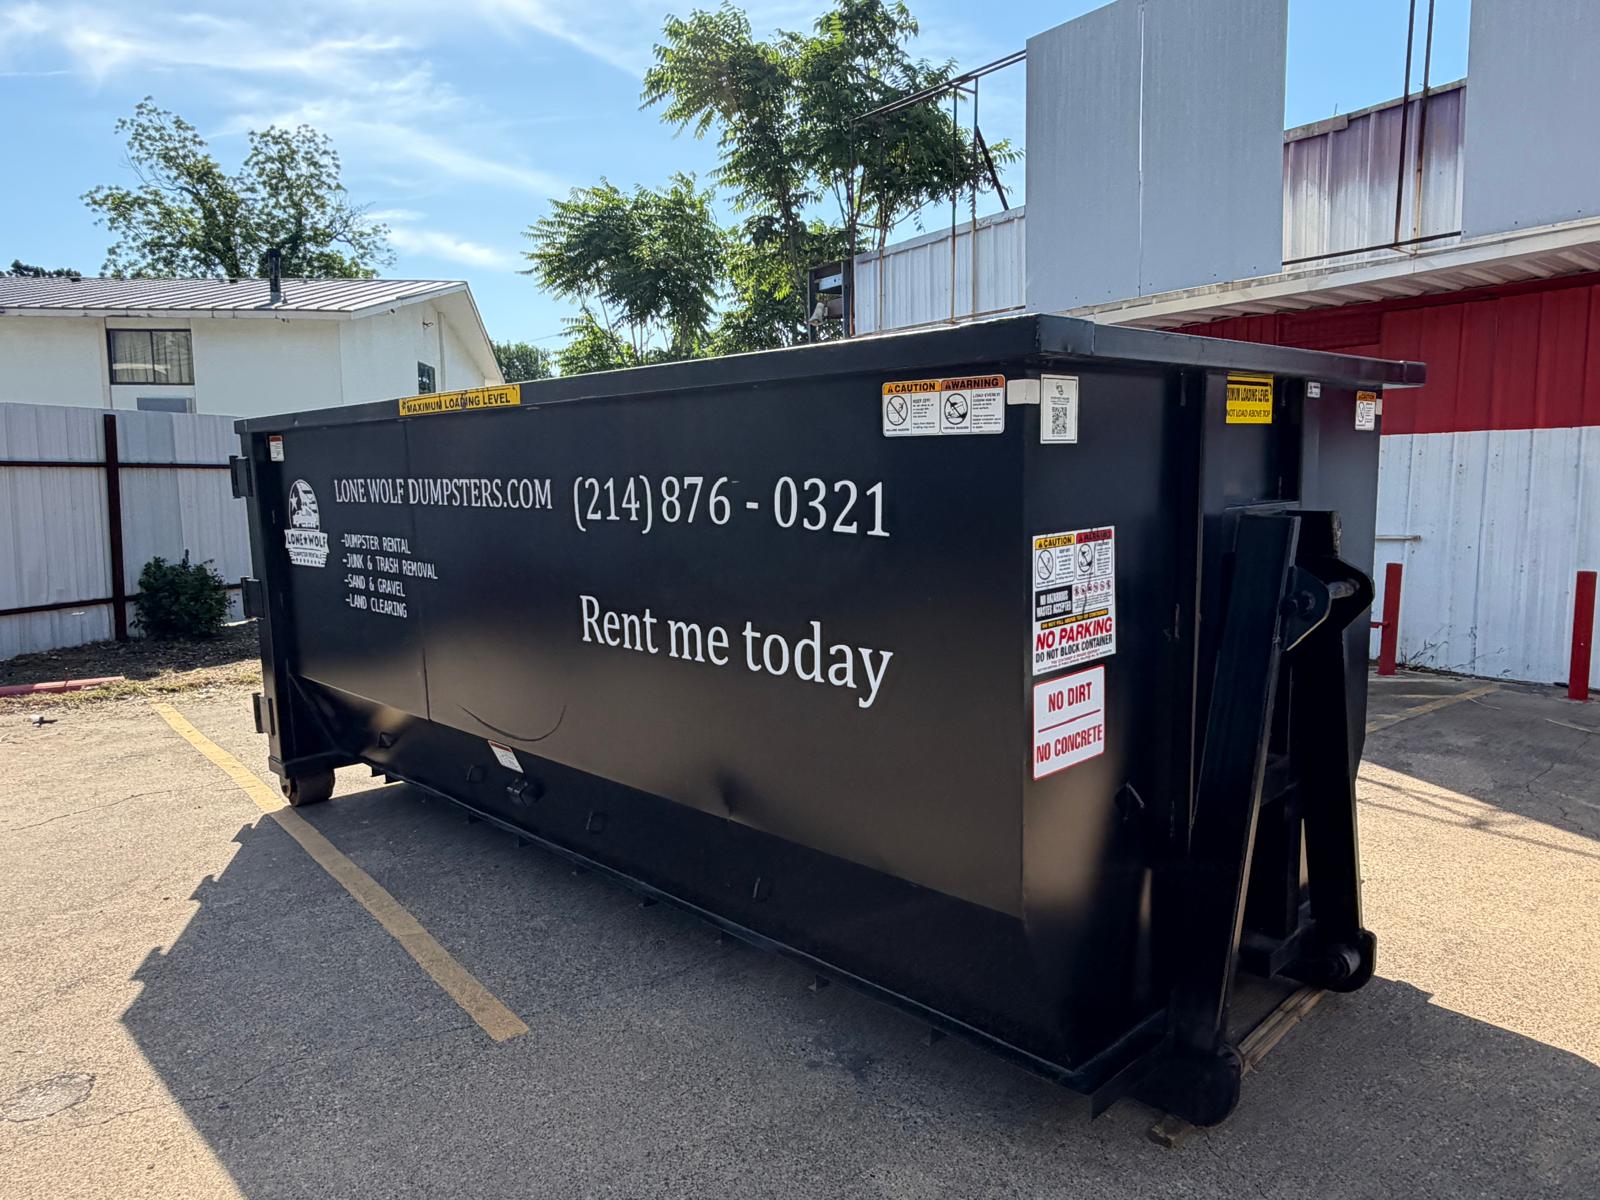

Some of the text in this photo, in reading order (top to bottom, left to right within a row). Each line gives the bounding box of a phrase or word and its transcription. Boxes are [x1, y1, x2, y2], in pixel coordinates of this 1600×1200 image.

[894, 382, 936, 393] CAUTION
[950, 378, 999, 391] WARNING
[407, 393, 511, 413] MAXIMUM LOADING LEVEL
[1249, 409, 1262, 417] ABOVE
[334, 479, 553, 509] LONE WOLF DUMPSTERS.COM
[774, 476, 890, 537] 0321
[287, 532, 326, 548] LONE WOLF
[382, 537, 411, 554] RENTAL
[1043, 536, 1072, 547] CAUTION
[367, 555, 373, 570] &
[375, 556, 399, 574] TRASH
[402, 560, 438, 580] REMOVAL
[369, 576, 374, 591] &
[378, 578, 405, 597] GRAVEL
[370, 597, 407, 618] CLEARING
[1036, 616, 1112, 652] NO PARKING
[579, 594, 894, 709] Rent me today
[1036, 652, 1044, 663] DO
[1047, 648, 1058, 660] NOT
[1061, 645, 1079, 657] BLOCK
[1081, 634, 1112, 651] CONTAINER
[1048, 681, 1092, 713] NO DIRT
[1036, 724, 1102, 764] NO CONCRETE
